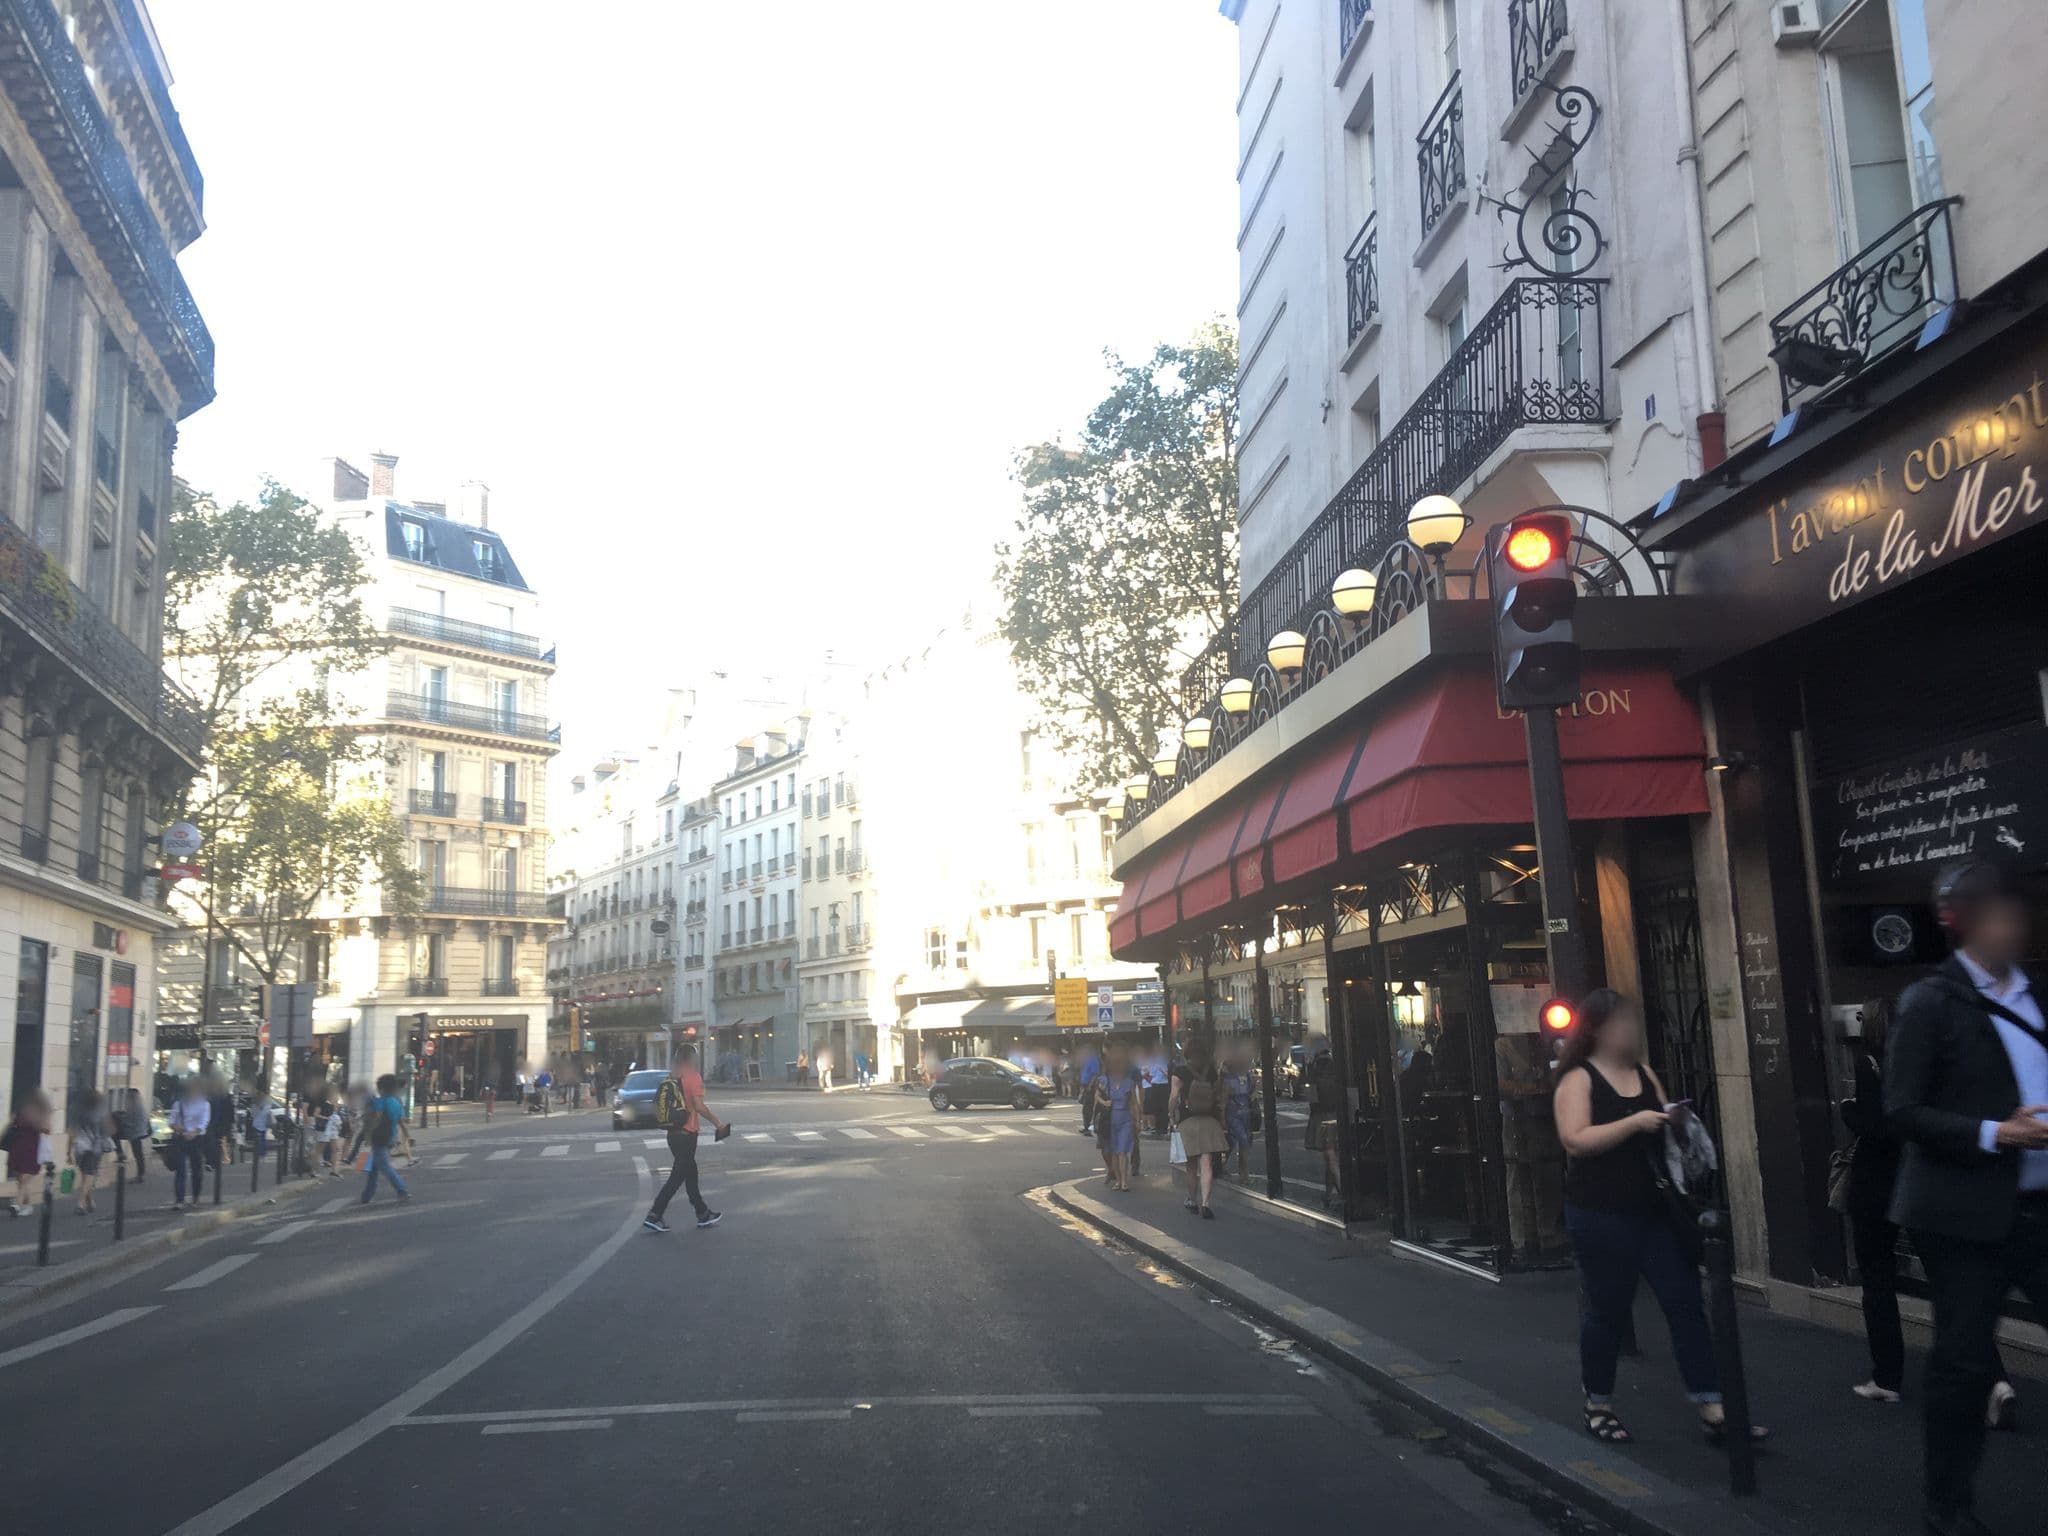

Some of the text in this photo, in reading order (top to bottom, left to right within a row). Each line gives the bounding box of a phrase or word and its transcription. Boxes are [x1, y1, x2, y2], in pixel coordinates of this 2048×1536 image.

[1767, 369, 2048, 565] l'avant compt
[1829, 460, 2044, 602] de la Mer
[1496, 688, 1632, 720] DTON
